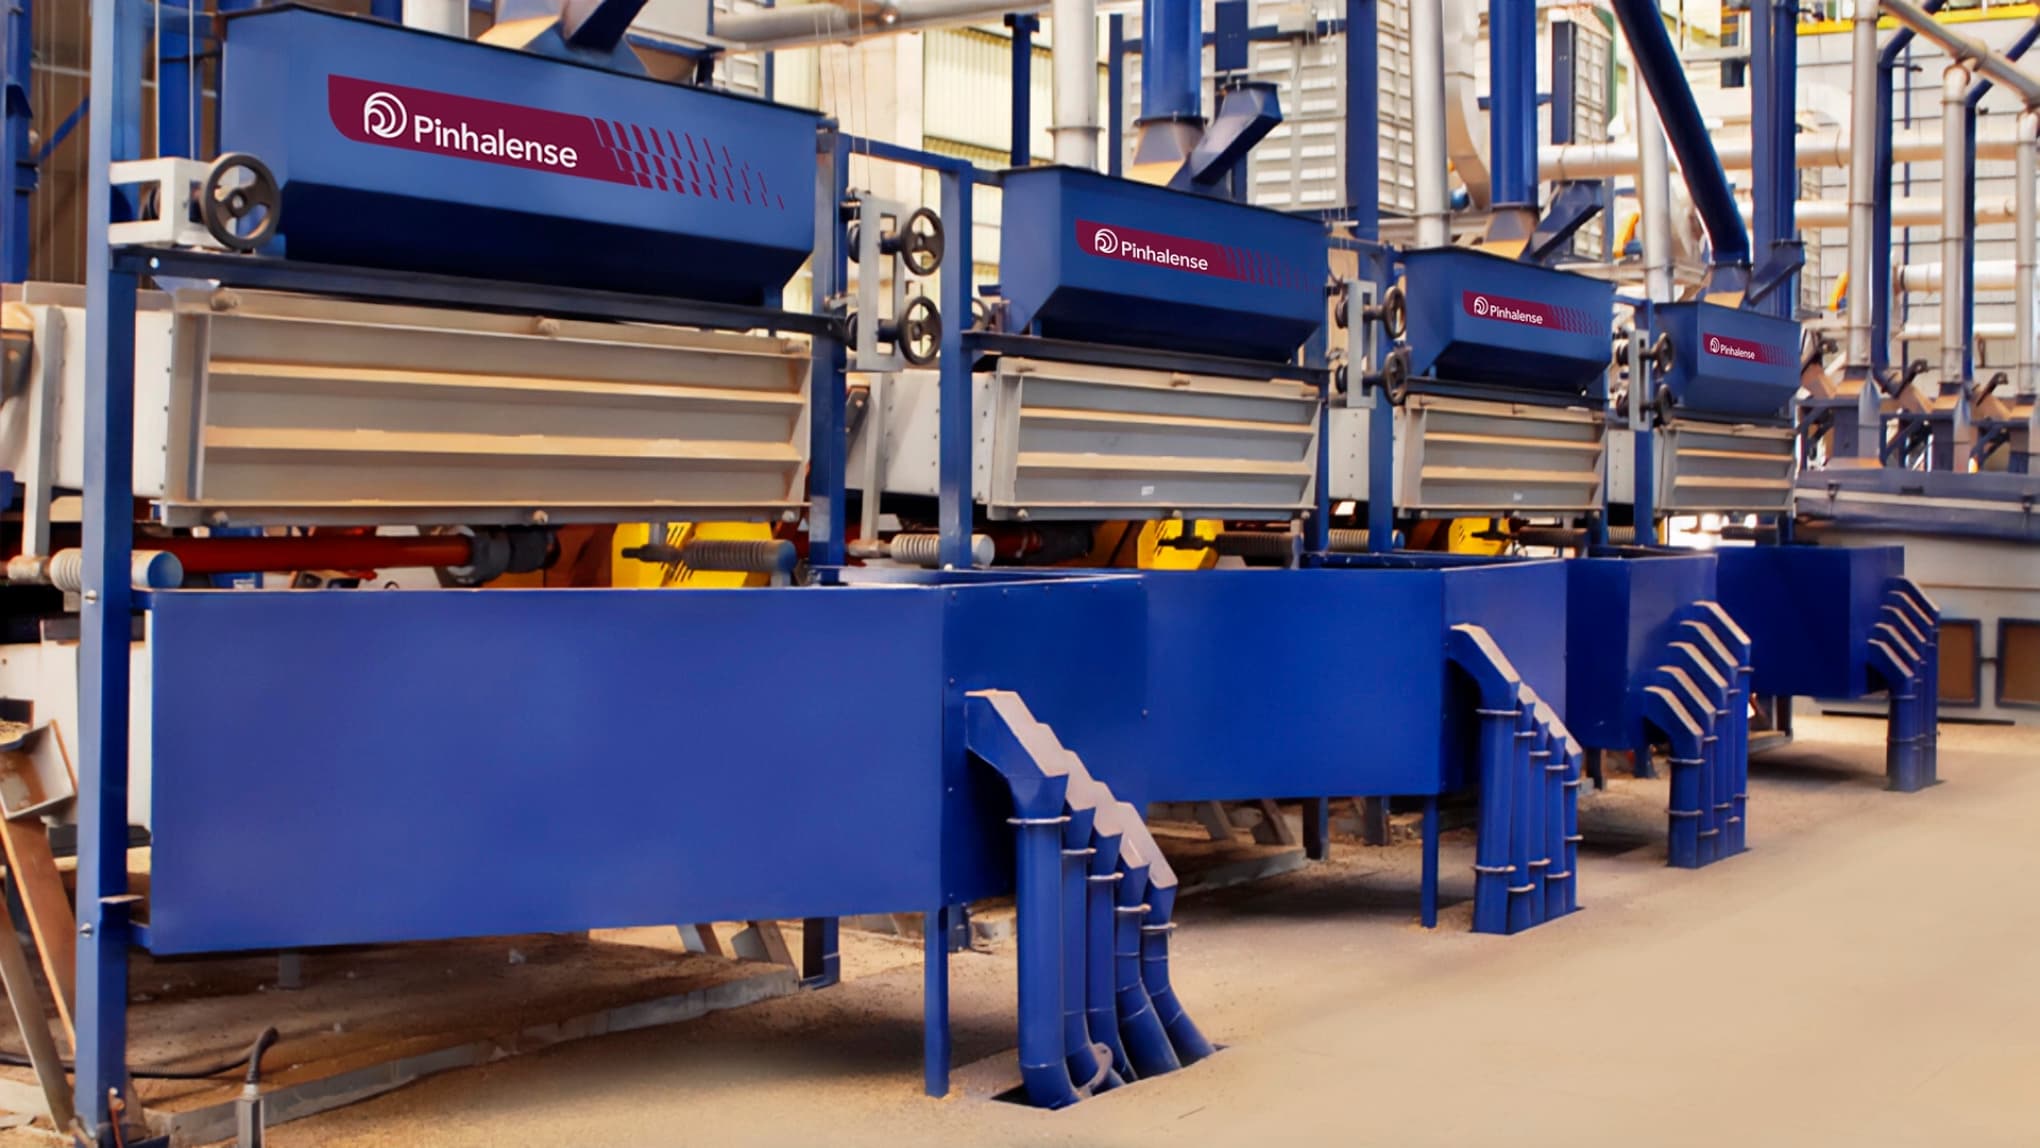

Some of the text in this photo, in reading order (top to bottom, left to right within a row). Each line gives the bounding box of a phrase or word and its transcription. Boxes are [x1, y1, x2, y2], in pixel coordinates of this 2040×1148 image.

[414, 115, 578, 168] Pinhalense
[1121, 241, 1208, 270] Pinhalense
[1490, 304, 1543, 324] Pinhalense
